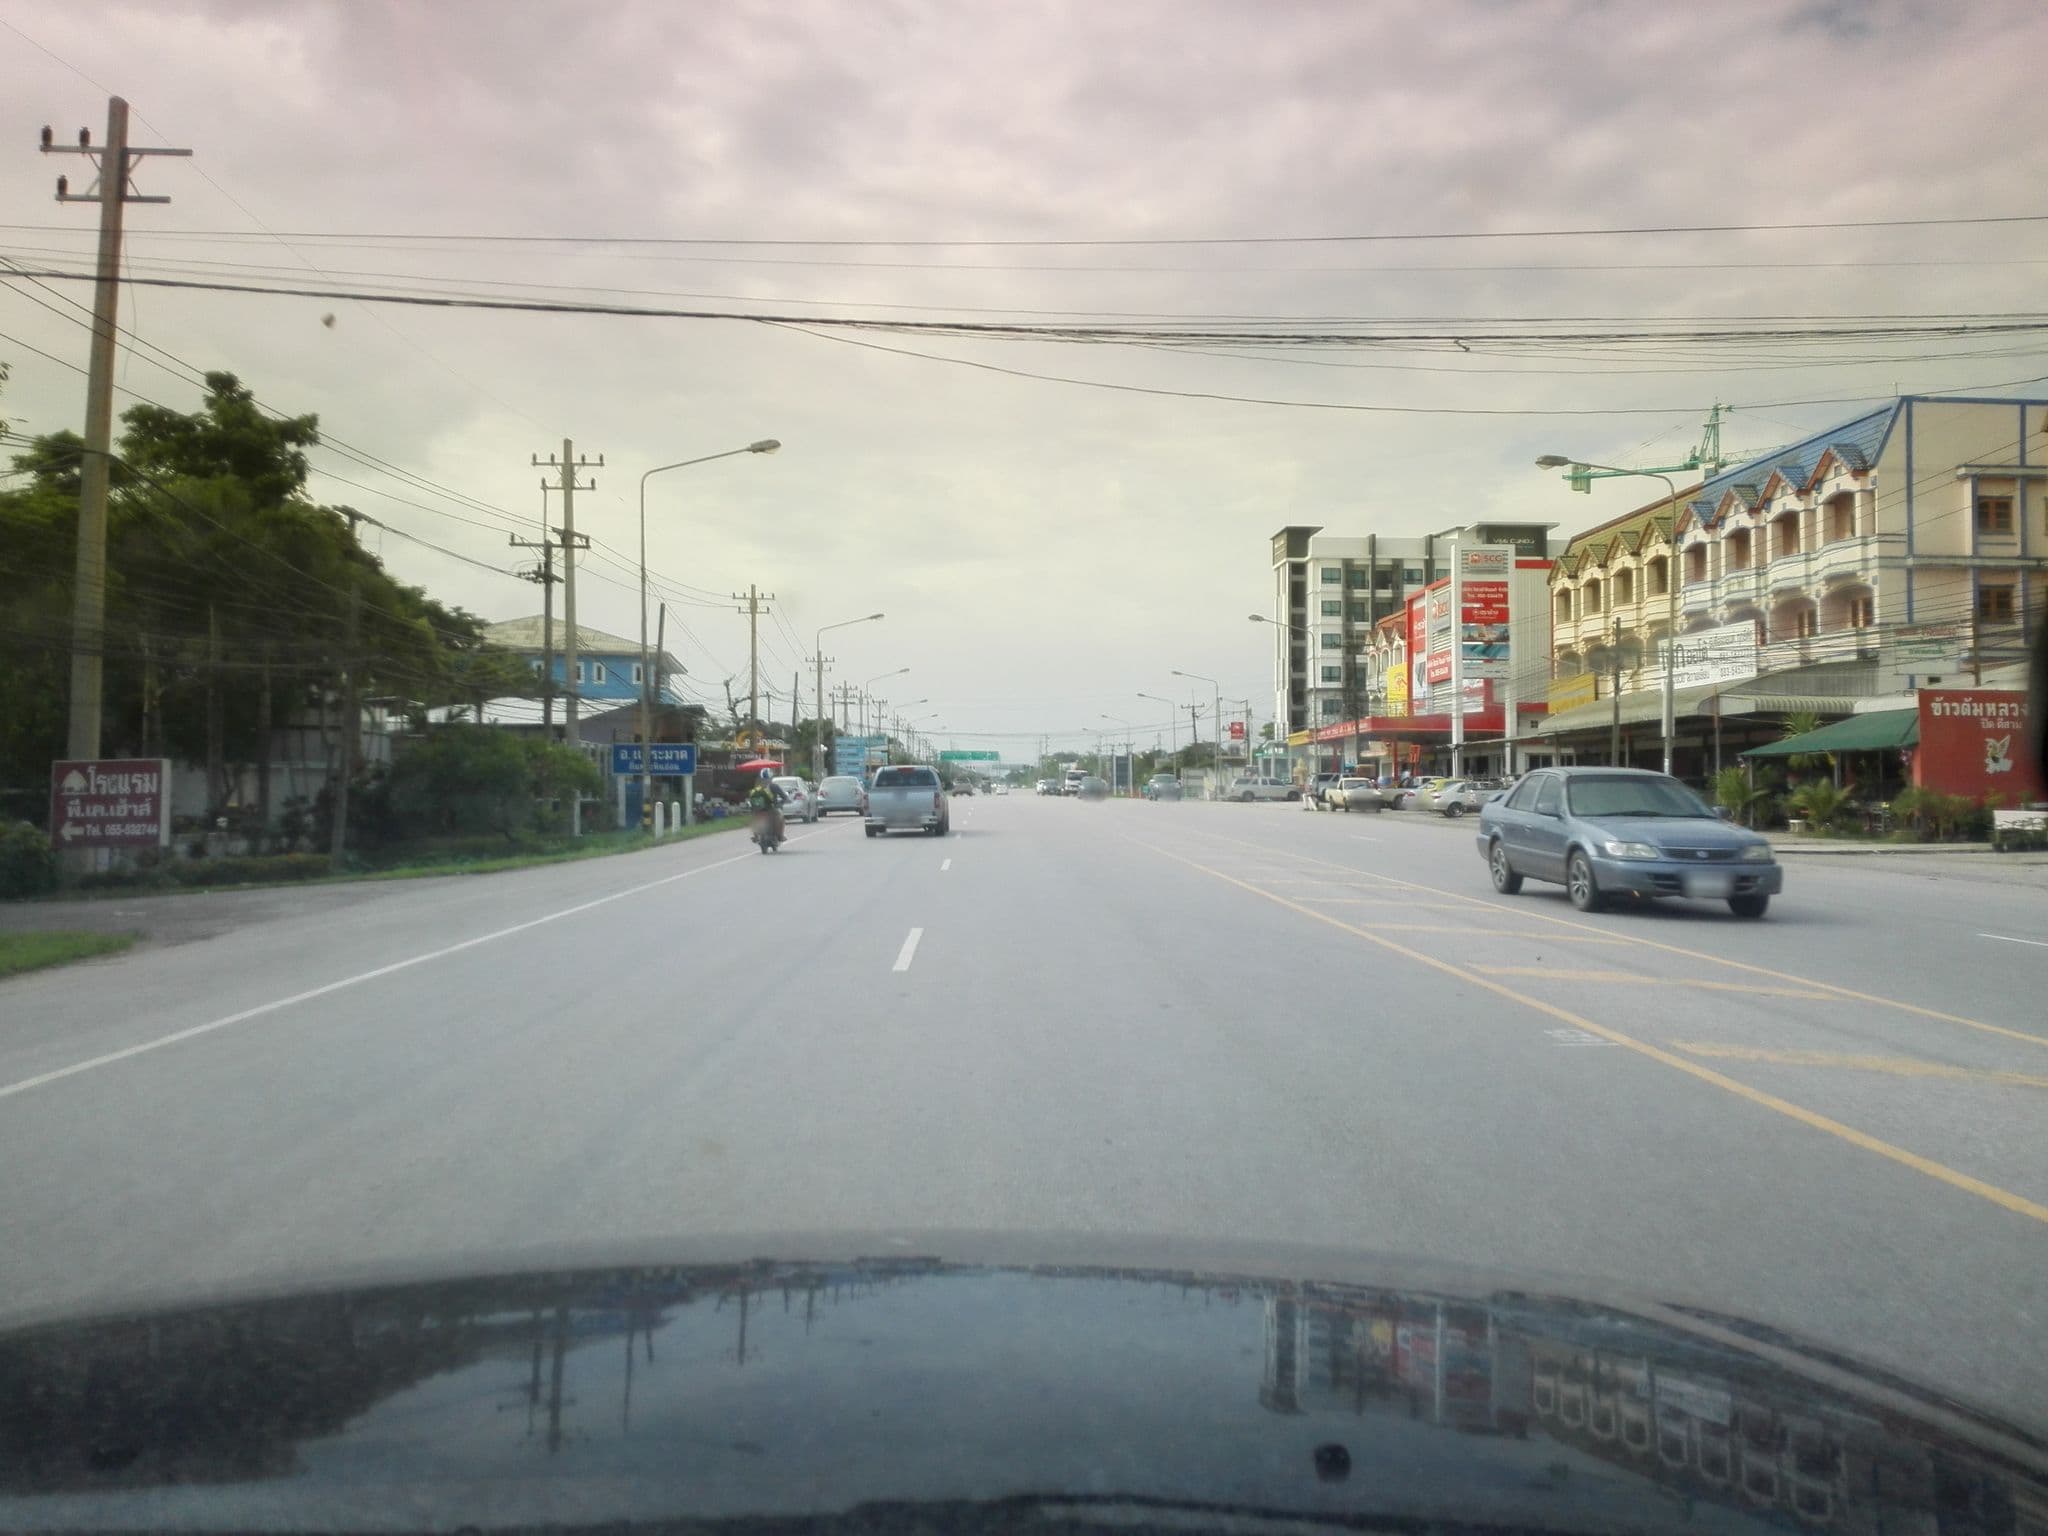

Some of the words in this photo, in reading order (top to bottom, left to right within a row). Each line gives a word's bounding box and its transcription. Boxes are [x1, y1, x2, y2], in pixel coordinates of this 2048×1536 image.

[633, 749, 688, 760] แระมาด
[88, 766, 158, 795] โรงแรม
